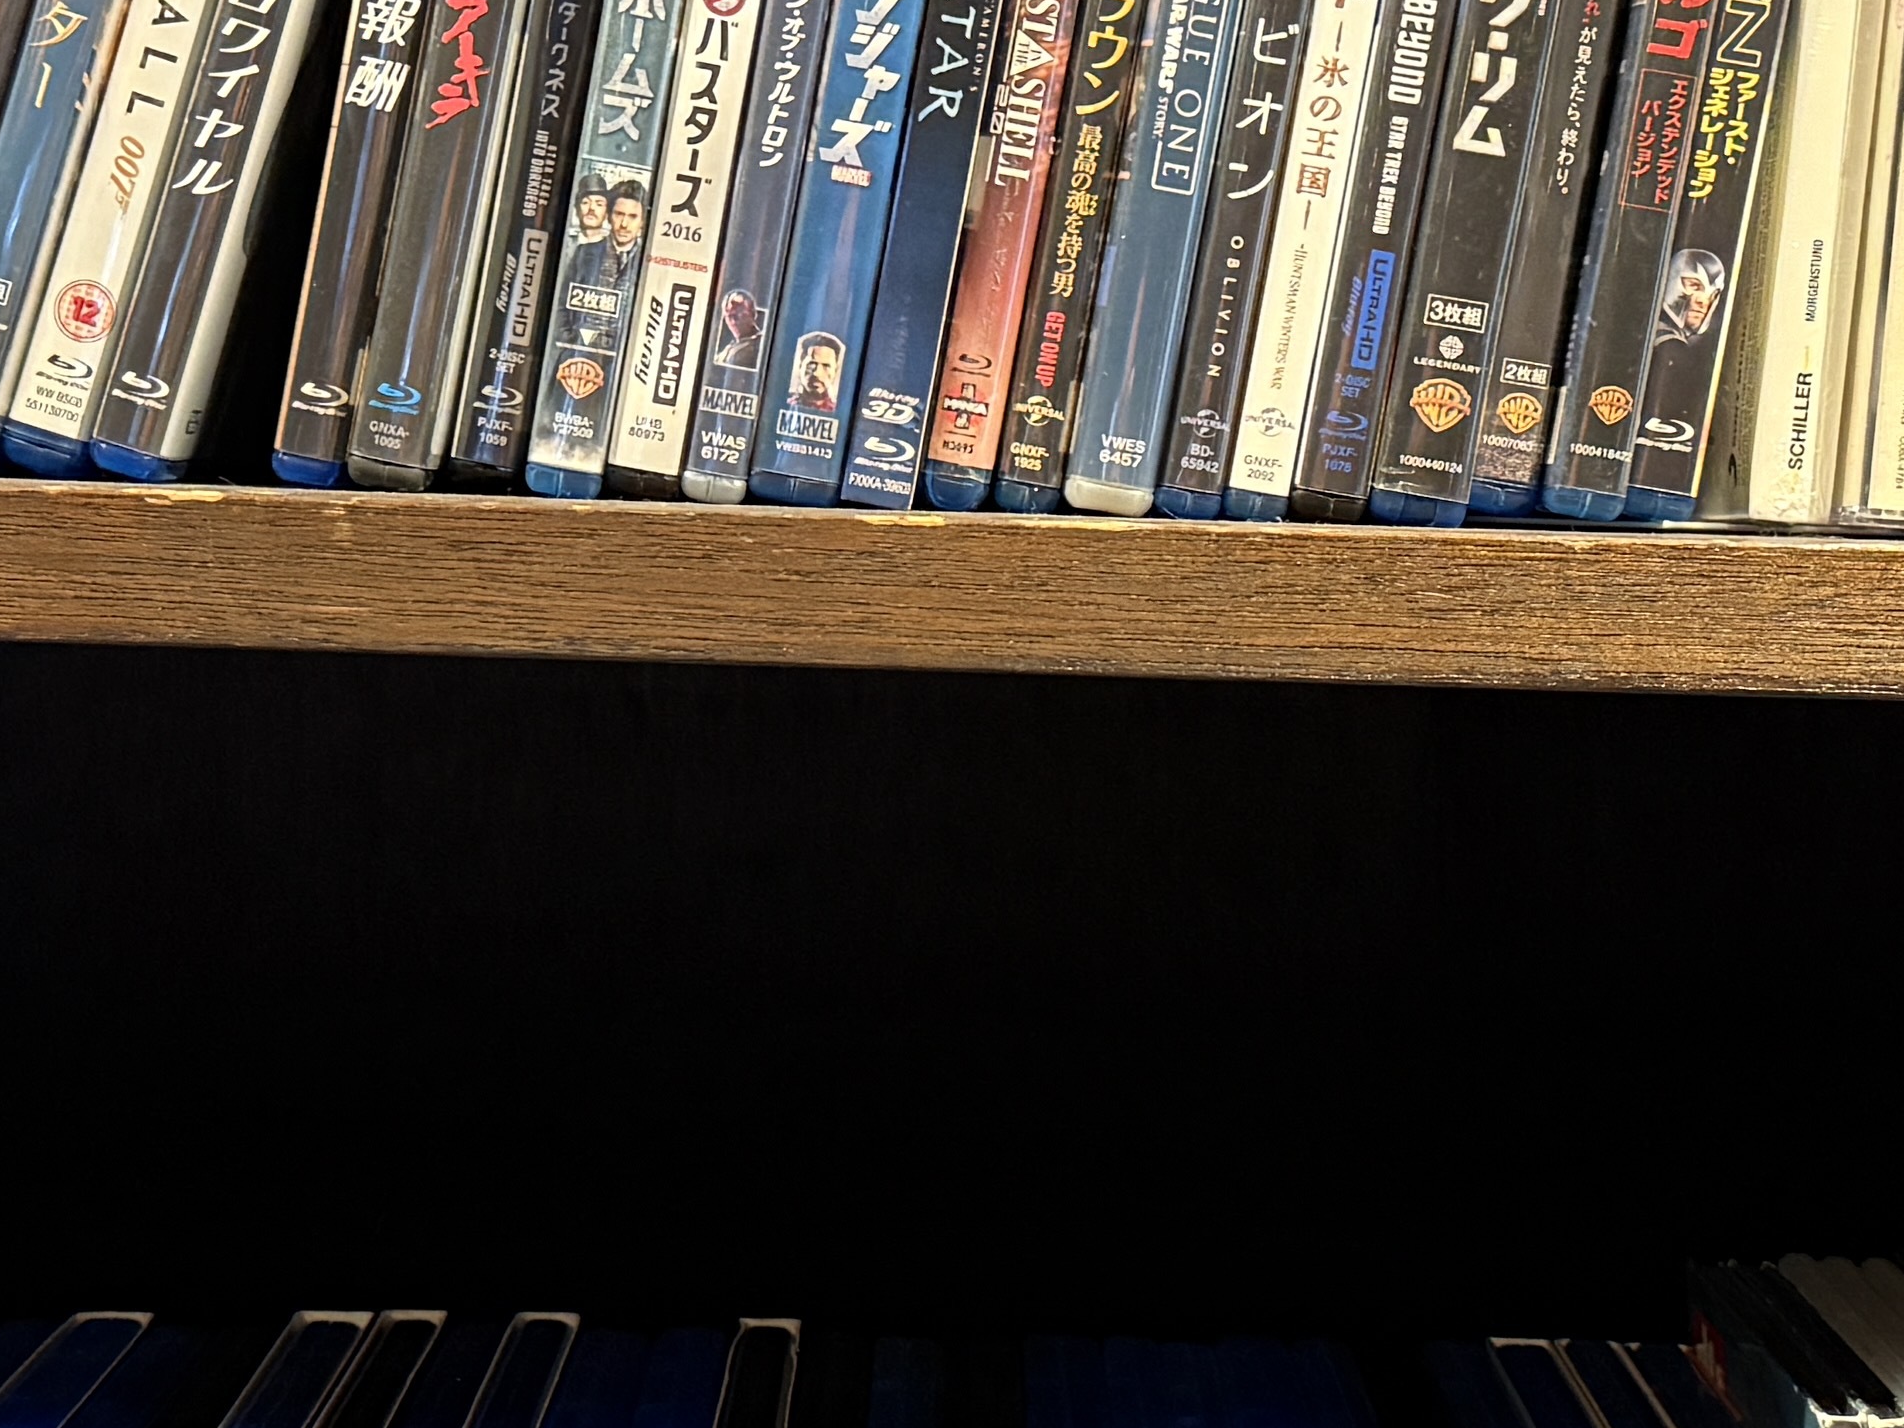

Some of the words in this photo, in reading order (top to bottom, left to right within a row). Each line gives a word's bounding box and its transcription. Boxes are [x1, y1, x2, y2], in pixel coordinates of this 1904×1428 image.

[1388, 0, 1436, 105] BEYOND
[1162, 87, 1203, 181] ONE
[661, 221, 703, 244] 2016
[1208, 235, 1243, 379] OBLIVION
[1805, 238, 1824, 322] MORGENSTUND
[703, 392, 757, 416] MARVEL
[1100, 434, 1146, 456] VWES
[1787, 373, 1814, 471] SCHILLER
[1098, 449, 1142, 466] 6457
